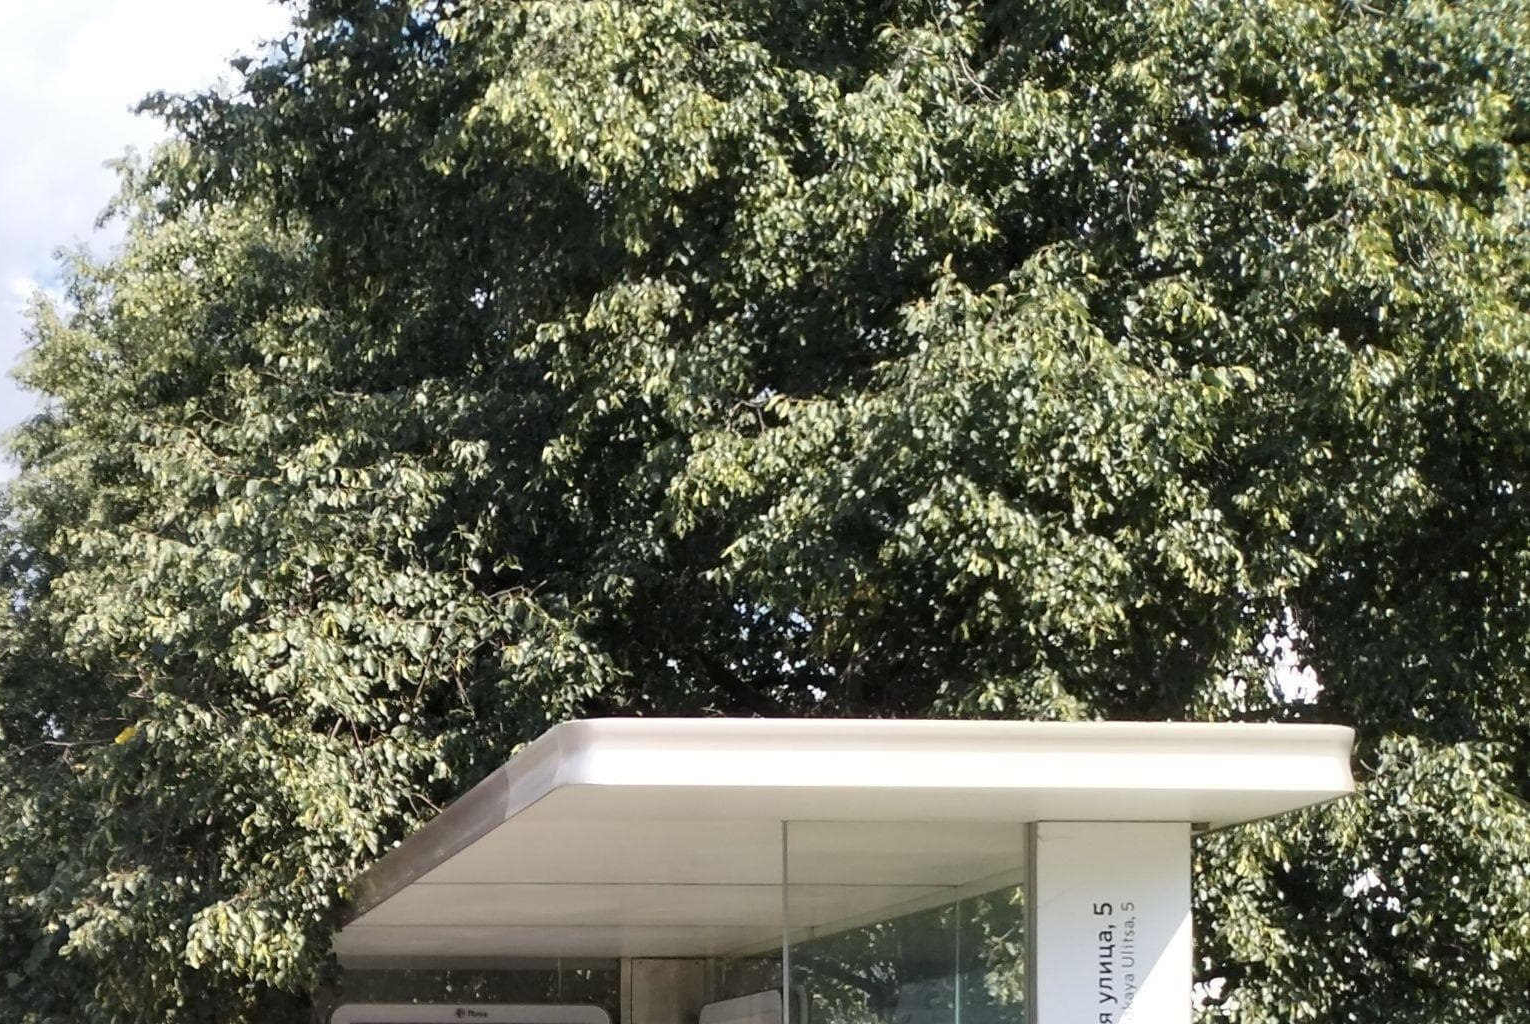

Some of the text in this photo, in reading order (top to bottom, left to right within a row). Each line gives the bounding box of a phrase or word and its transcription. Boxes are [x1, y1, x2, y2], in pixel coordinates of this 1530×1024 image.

[1093, 902, 1113, 916] 5
[1120, 902, 1135, 912] 5
[1098, 925, 1118, 1004] улица,
